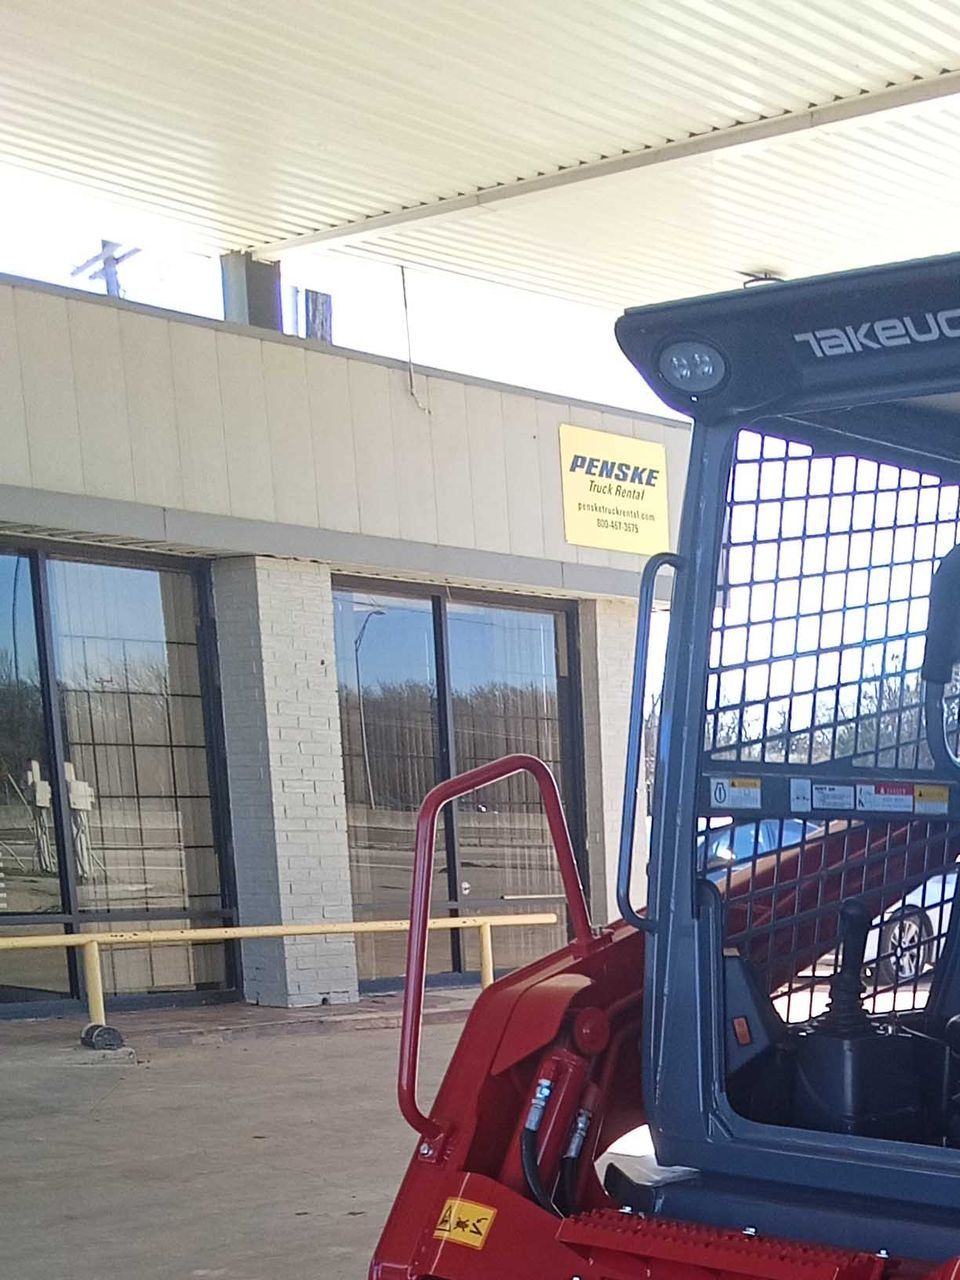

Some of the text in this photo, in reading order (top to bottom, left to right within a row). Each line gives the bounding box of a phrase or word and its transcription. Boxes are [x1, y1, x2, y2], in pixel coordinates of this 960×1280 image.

[569, 454, 659, 486] PENSKE
[589, 479, 644, 500] Truck Rental
[577, 502, 655, 521] pensketruckrental.com
